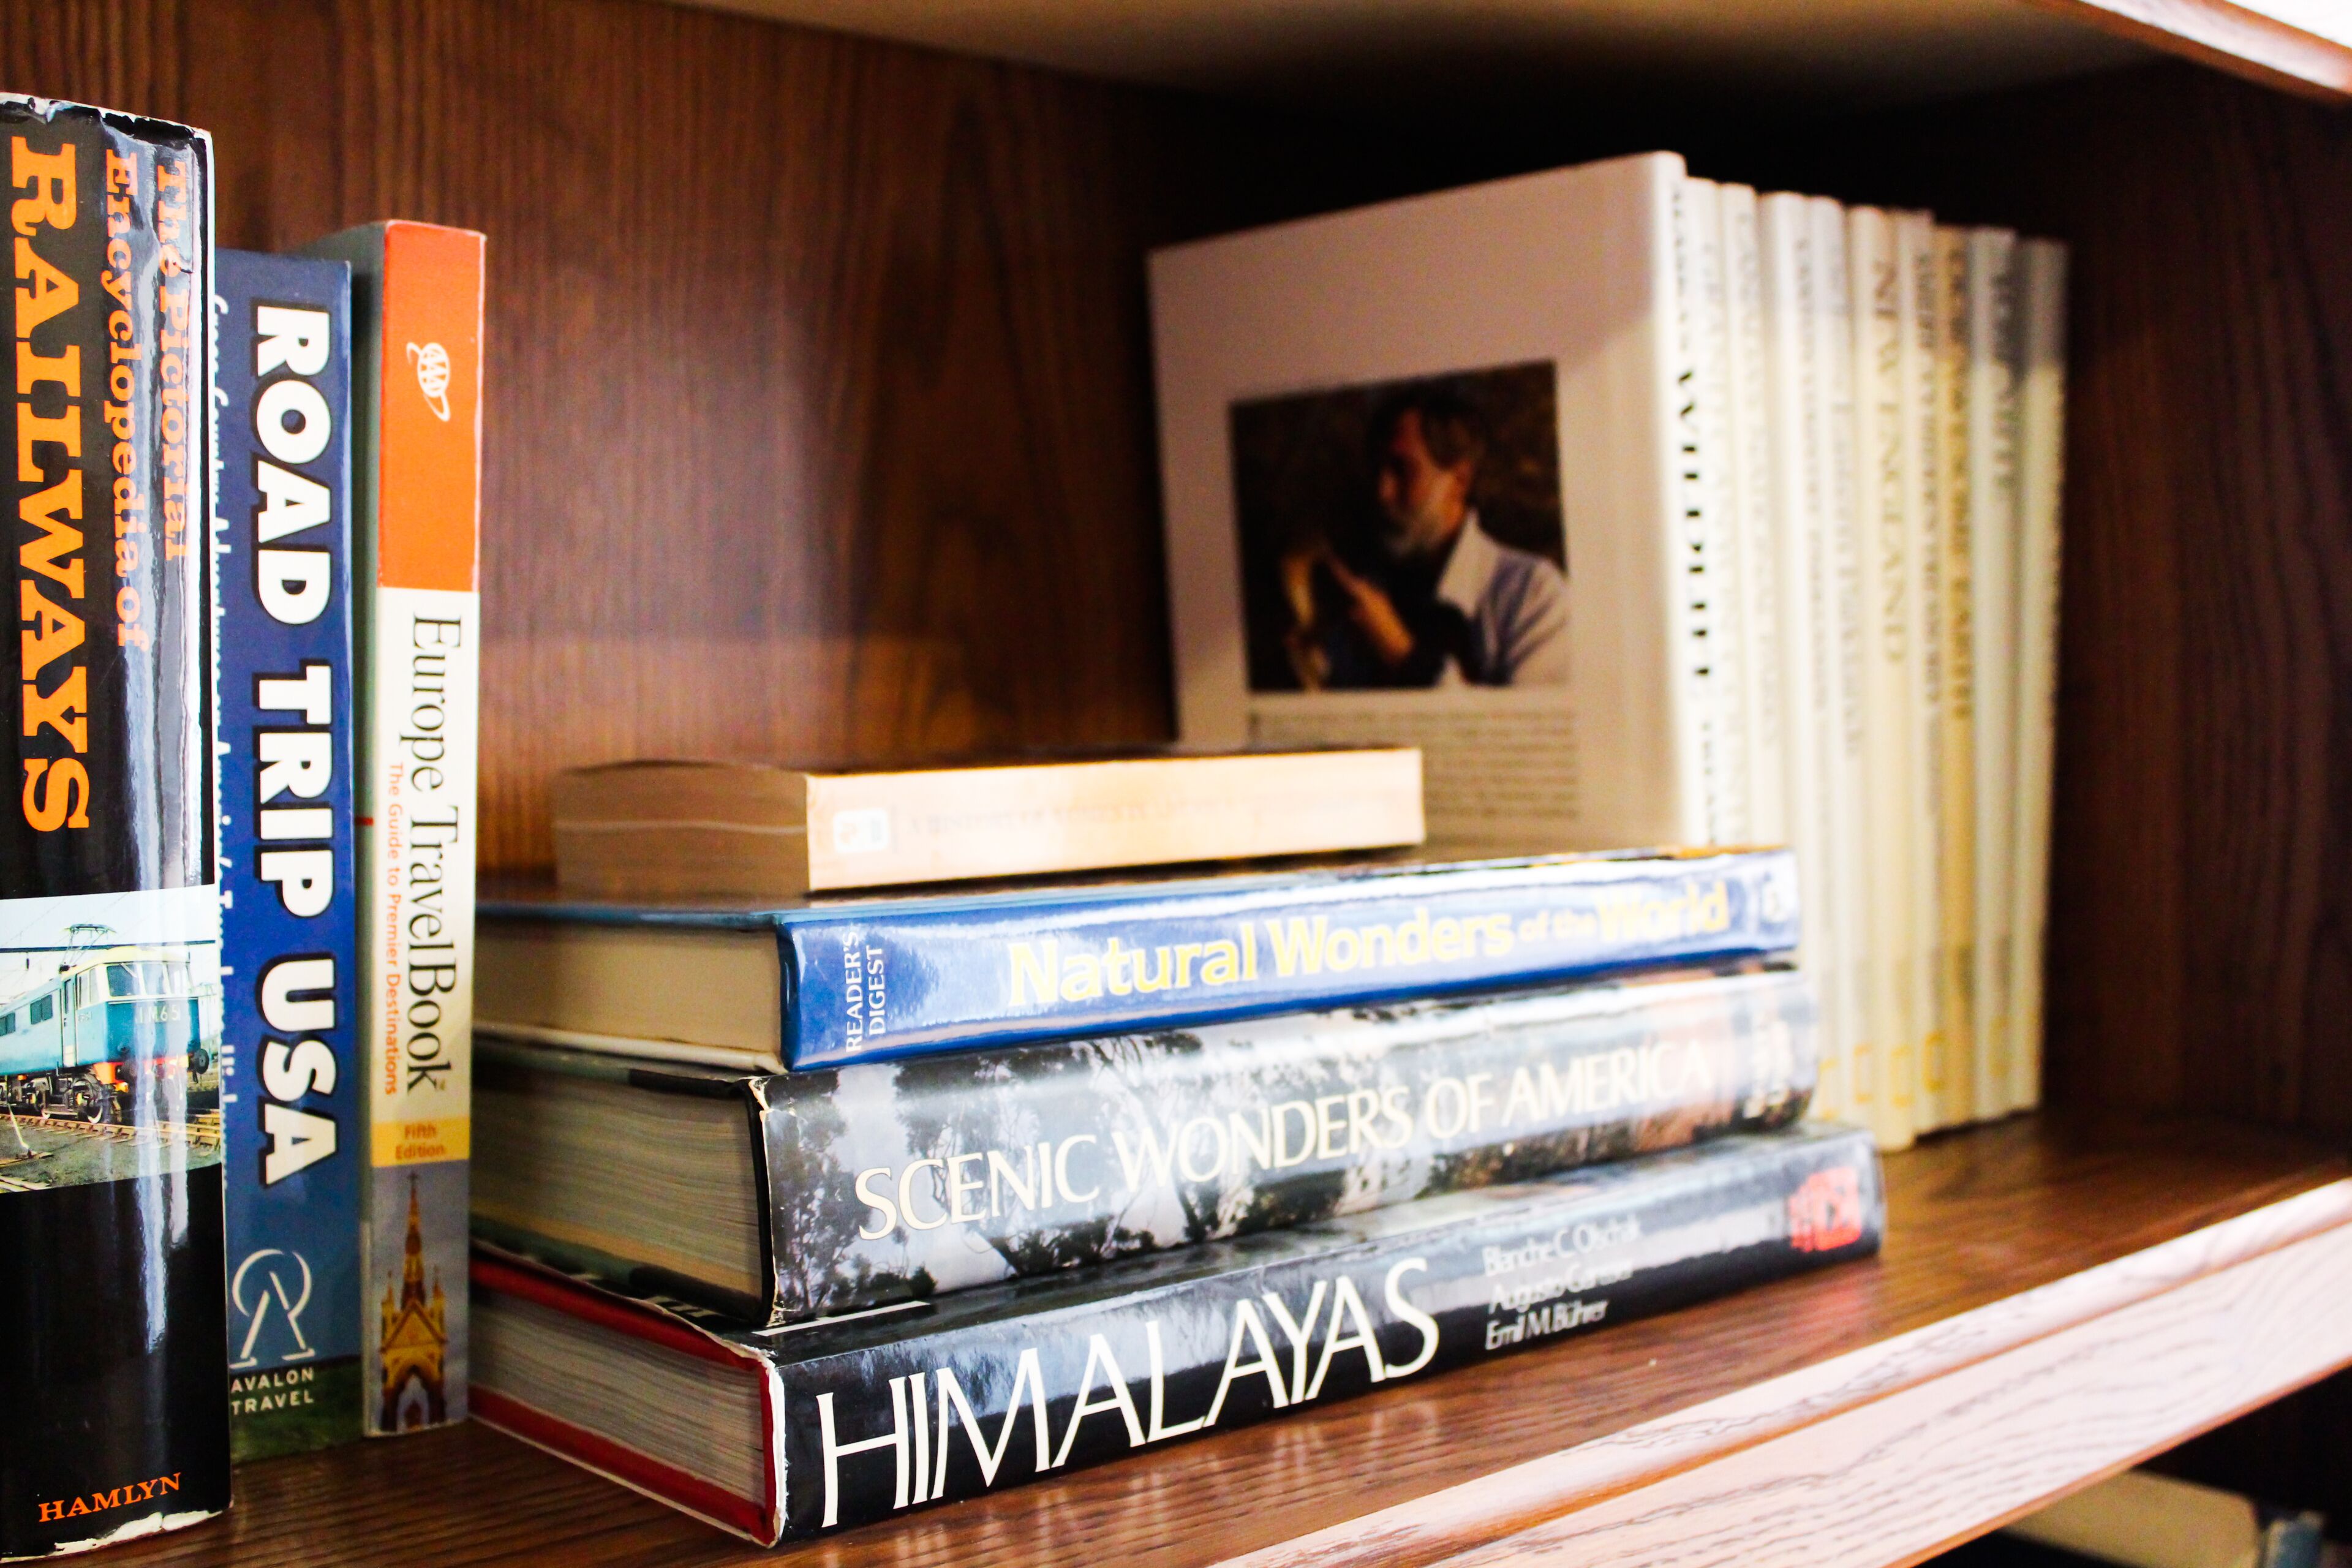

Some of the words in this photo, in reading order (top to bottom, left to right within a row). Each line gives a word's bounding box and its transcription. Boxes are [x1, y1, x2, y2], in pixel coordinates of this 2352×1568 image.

[157, 160, 187, 277] The
[101, 149, 149, 577] Encyclopedia
[159, 285, 191, 560] Pictorial
[10, 136, 90, 832] RAILWAYS
[256, 305, 332, 624] ROAD
[116, 586, 149, 651] of
[399, 612, 461, 792] Europe
[258, 665, 334, 918] TRIP
[387, 803, 402, 859] Guide
[389, 763, 404, 796] The
[385, 893, 402, 967] Premier
[387, 867, 401, 886] to
[407, 805, 459, 1091] TravelBook
[843, 922, 863, 1053] READER'S
[865, 944, 886, 1036] DIGEST
[1008, 921, 1257, 1008] Natural
[1267, 907, 1516, 976] Wonders
[1518, 908, 1547, 942] of
[1595, 878, 1730, 941] World
[261, 957, 337, 1185] USA
[385, 973, 401, 1095] Destinations
[395, 1142, 446, 1160] Edition
[404, 1122, 437, 1139] Fifth
[854, 1134, 1101, 1240] SCENIC
[1110, 1085, 1414, 1193] WONDERS
[1423, 1072, 1495, 1141] OF
[1500, 1039, 1716, 1128] AMERICA
[231, 1366, 314, 1393] AVALON
[231, 1389, 314, 1415] TRAVEL
[816, 1257, 1440, 1528] HIMALAYAS
[38, 1472, 181, 1523] HAMLYN
